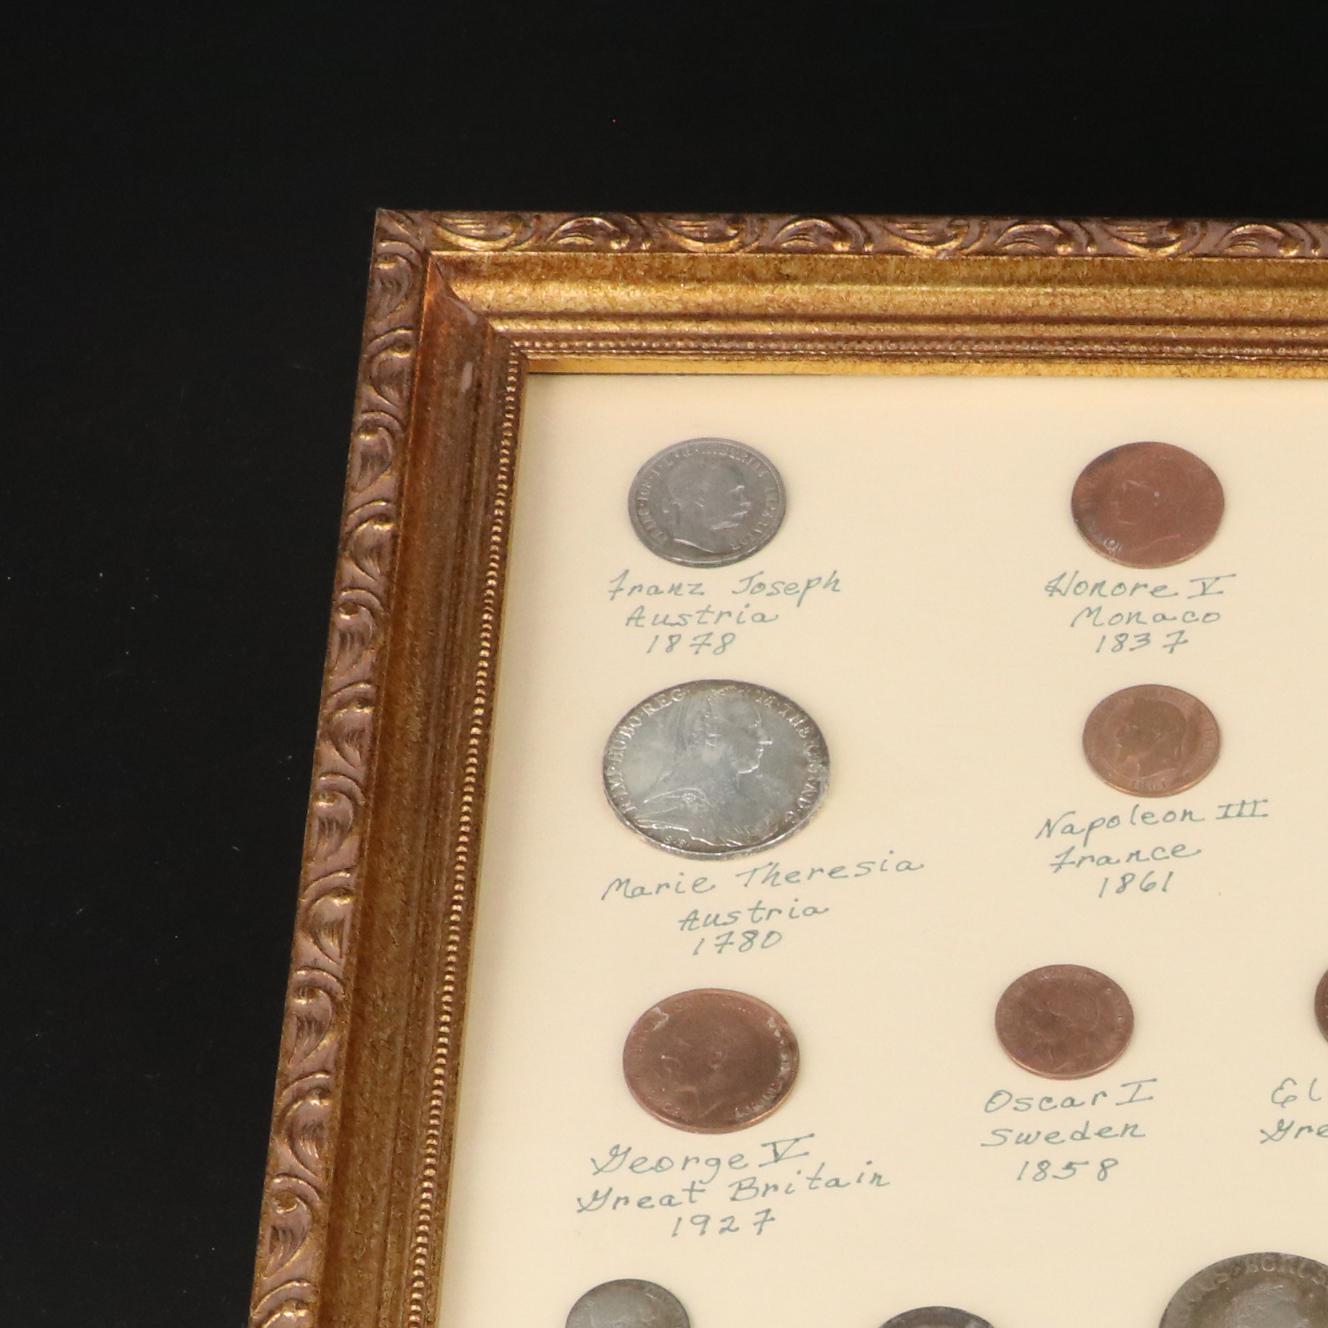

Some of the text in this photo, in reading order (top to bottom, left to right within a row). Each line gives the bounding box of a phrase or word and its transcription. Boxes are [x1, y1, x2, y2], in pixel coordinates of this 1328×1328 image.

[608, 569, 841, 607] Franz Joseph
[1044, 570, 1237, 599] Honore V
[625, 604, 779, 628] Austria
[1070, 606, 1221, 628] Monaco
[646, 632, 736, 655] 1878
[1095, 630, 1189, 654] 1837
[1035, 799, 1269, 848] Napoleon III
[1050, 844, 1202, 873] France
[601, 850, 924, 901] Marie Theresia
[1098, 870, 1174, 898] 1861
[678, 898, 830, 931] Austria
[692, 929, 783, 956] 1780
[984, 1078, 1158, 1113] Oscar I
[590, 1133, 815, 1184] George V
[1016, 1158, 1119, 1182] 1858
[577, 1159, 891, 1214] Great Britain
[672, 1208, 776, 1237] 1927
